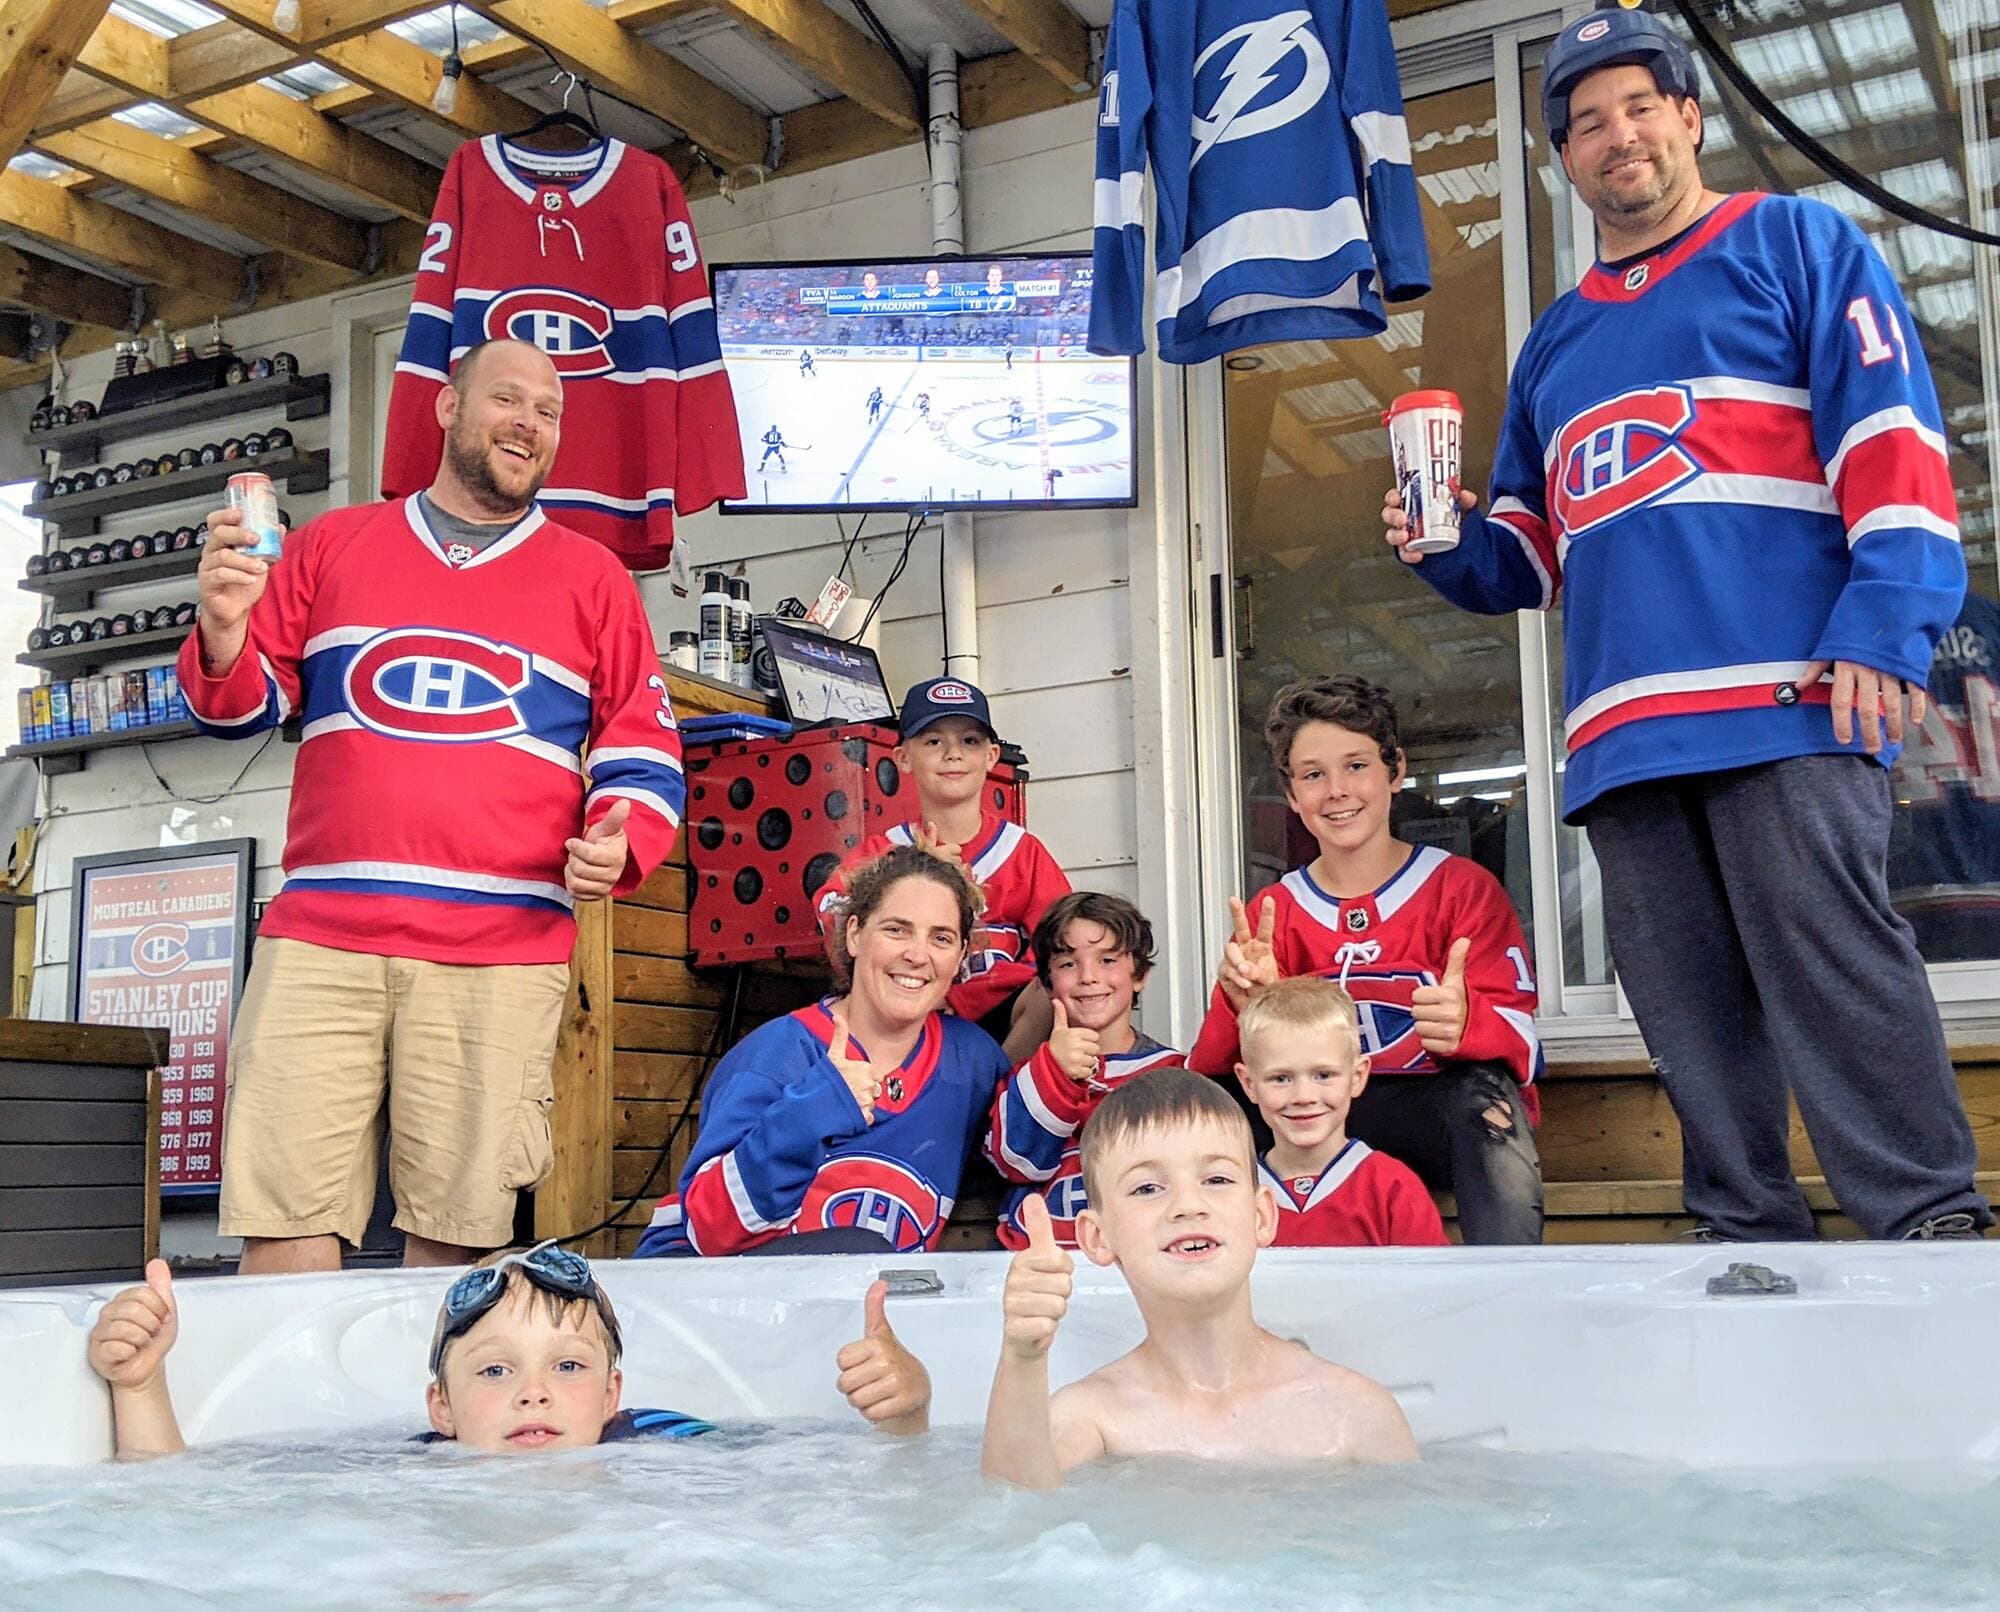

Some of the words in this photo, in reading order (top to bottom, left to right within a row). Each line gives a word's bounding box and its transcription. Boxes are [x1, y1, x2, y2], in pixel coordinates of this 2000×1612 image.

[417, 221, 453, 274] 2
[664, 220, 699, 273] 9
[1018, 284, 1046, 294] MATCH
[861, 301, 929, 313] ATTAQUANTS
[968, 299, 983, 310] TB
[1846, 296, 1910, 376] 1
[93, 899, 159, 921] MONTREAL
[162, 892, 232, 914] CANADIENS
[1505, 945, 1536, 992] 1
[88, 983, 183, 1015] STANLEY
[188, 979, 228, 1009] CUP
[193, 1041, 214, 1057] 1931
[191, 1063, 215, 1080] 1956
[162, 1087, 184, 1104] 959
[190, 1086, 214, 1102] 1960
[161, 1110, 182, 1126] 968
[188, 1108, 213, 1125] 1969
[160, 1133, 181, 1149] 976
[187, 1131, 212, 1148] 1977
[185, 1154, 211, 1171] 1993
